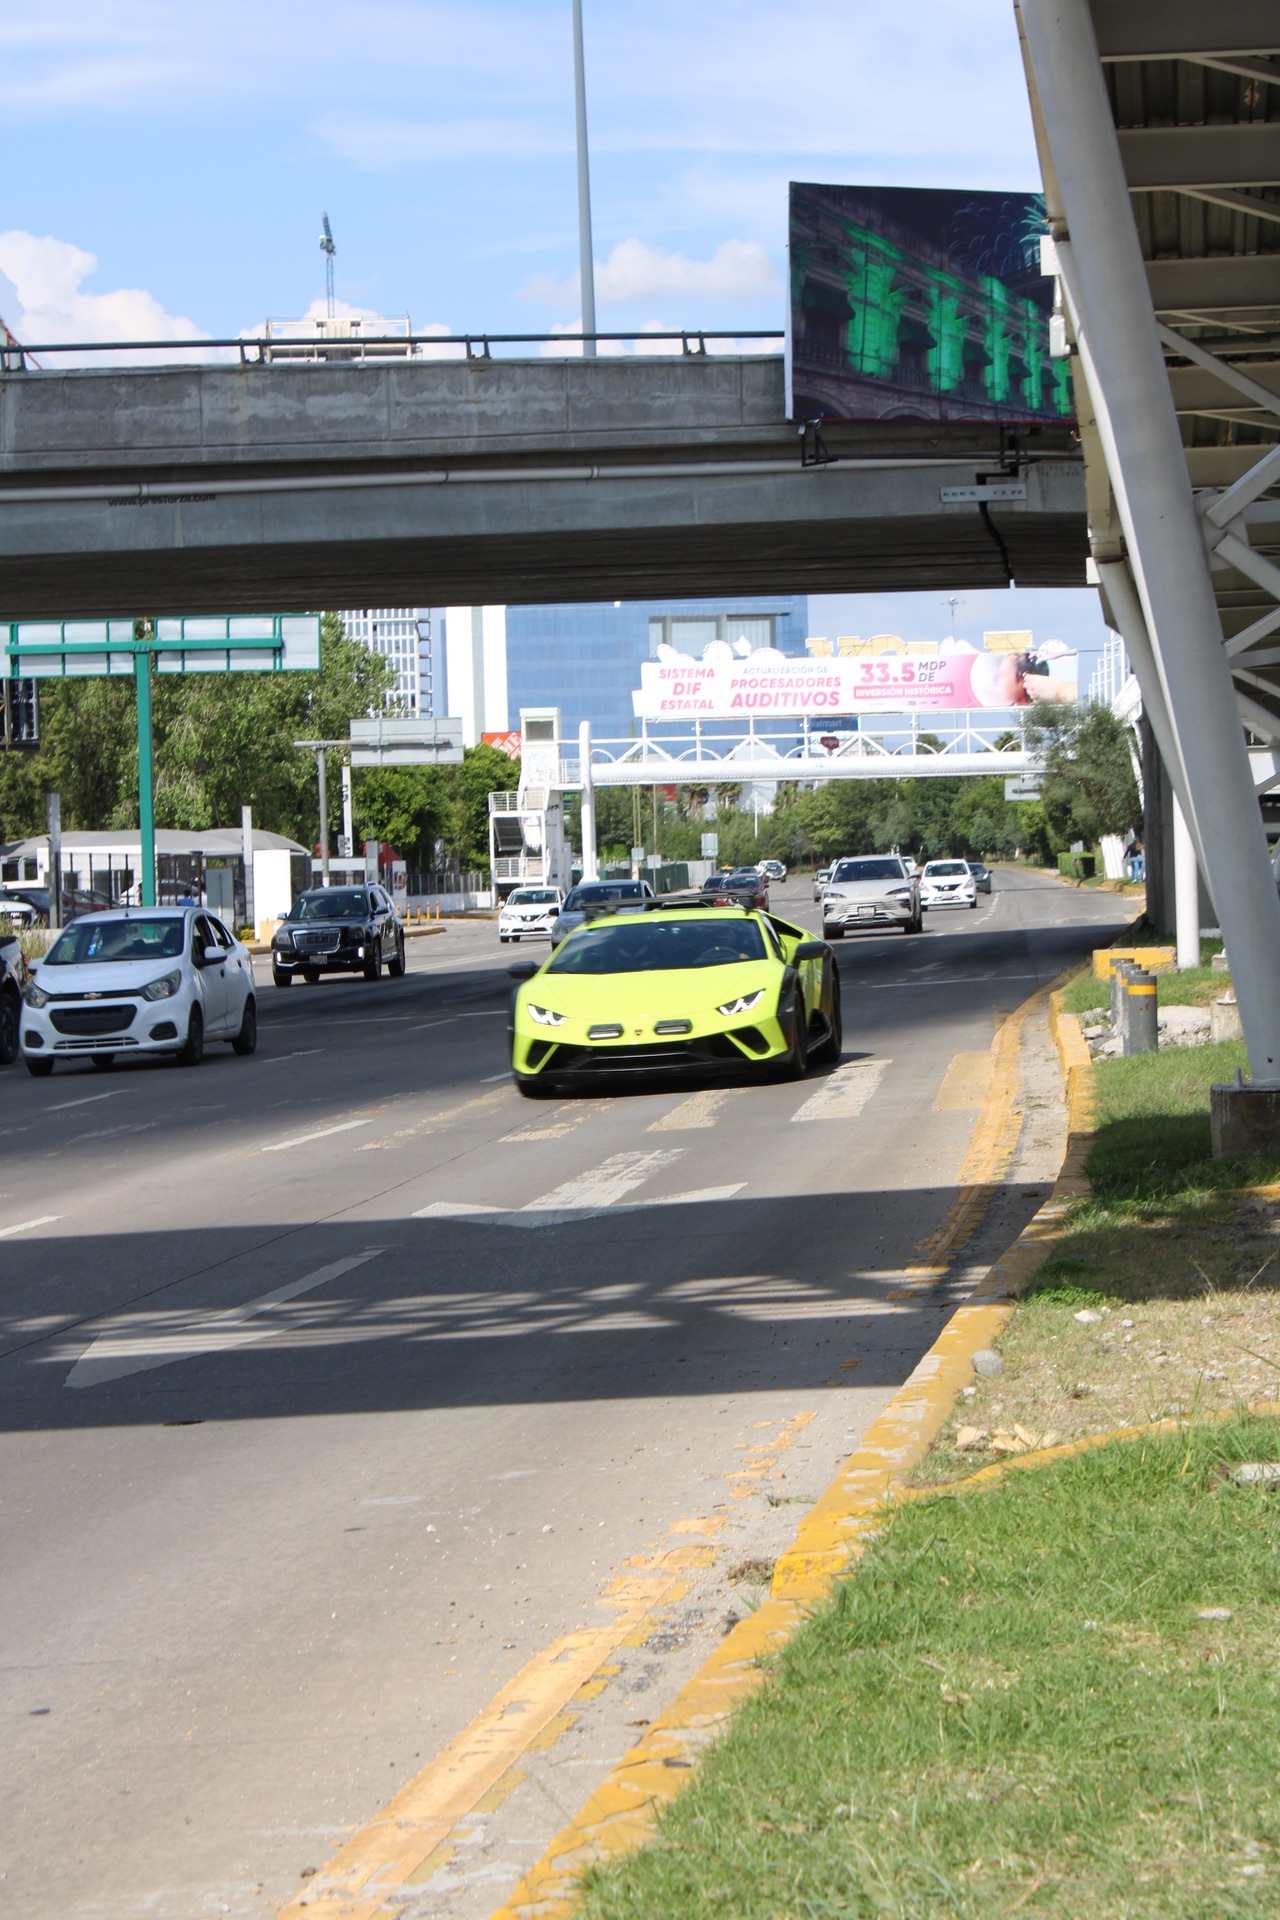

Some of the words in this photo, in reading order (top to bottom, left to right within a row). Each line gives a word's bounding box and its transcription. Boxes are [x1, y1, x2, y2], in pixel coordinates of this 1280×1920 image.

[659, 668, 715, 679] SISTEMA
[743, 666, 814, 675] ACTUALIZACIÓN
[818, 666, 829, 674] DE
[860, 662, 915, 683] 33.5
[918, 661, 947, 671] MDP
[730, 677, 841, 689] PROCESADORES
[918, 672, 936, 682] DE
[673, 682, 702, 695] DIF
[855, 686, 903, 697] INVERSIÓN
[904, 684, 952, 696] HISTÓRICA
[660, 700, 715, 710] ESTATAL
[730, 691, 840, 708] AUDITIVOS
